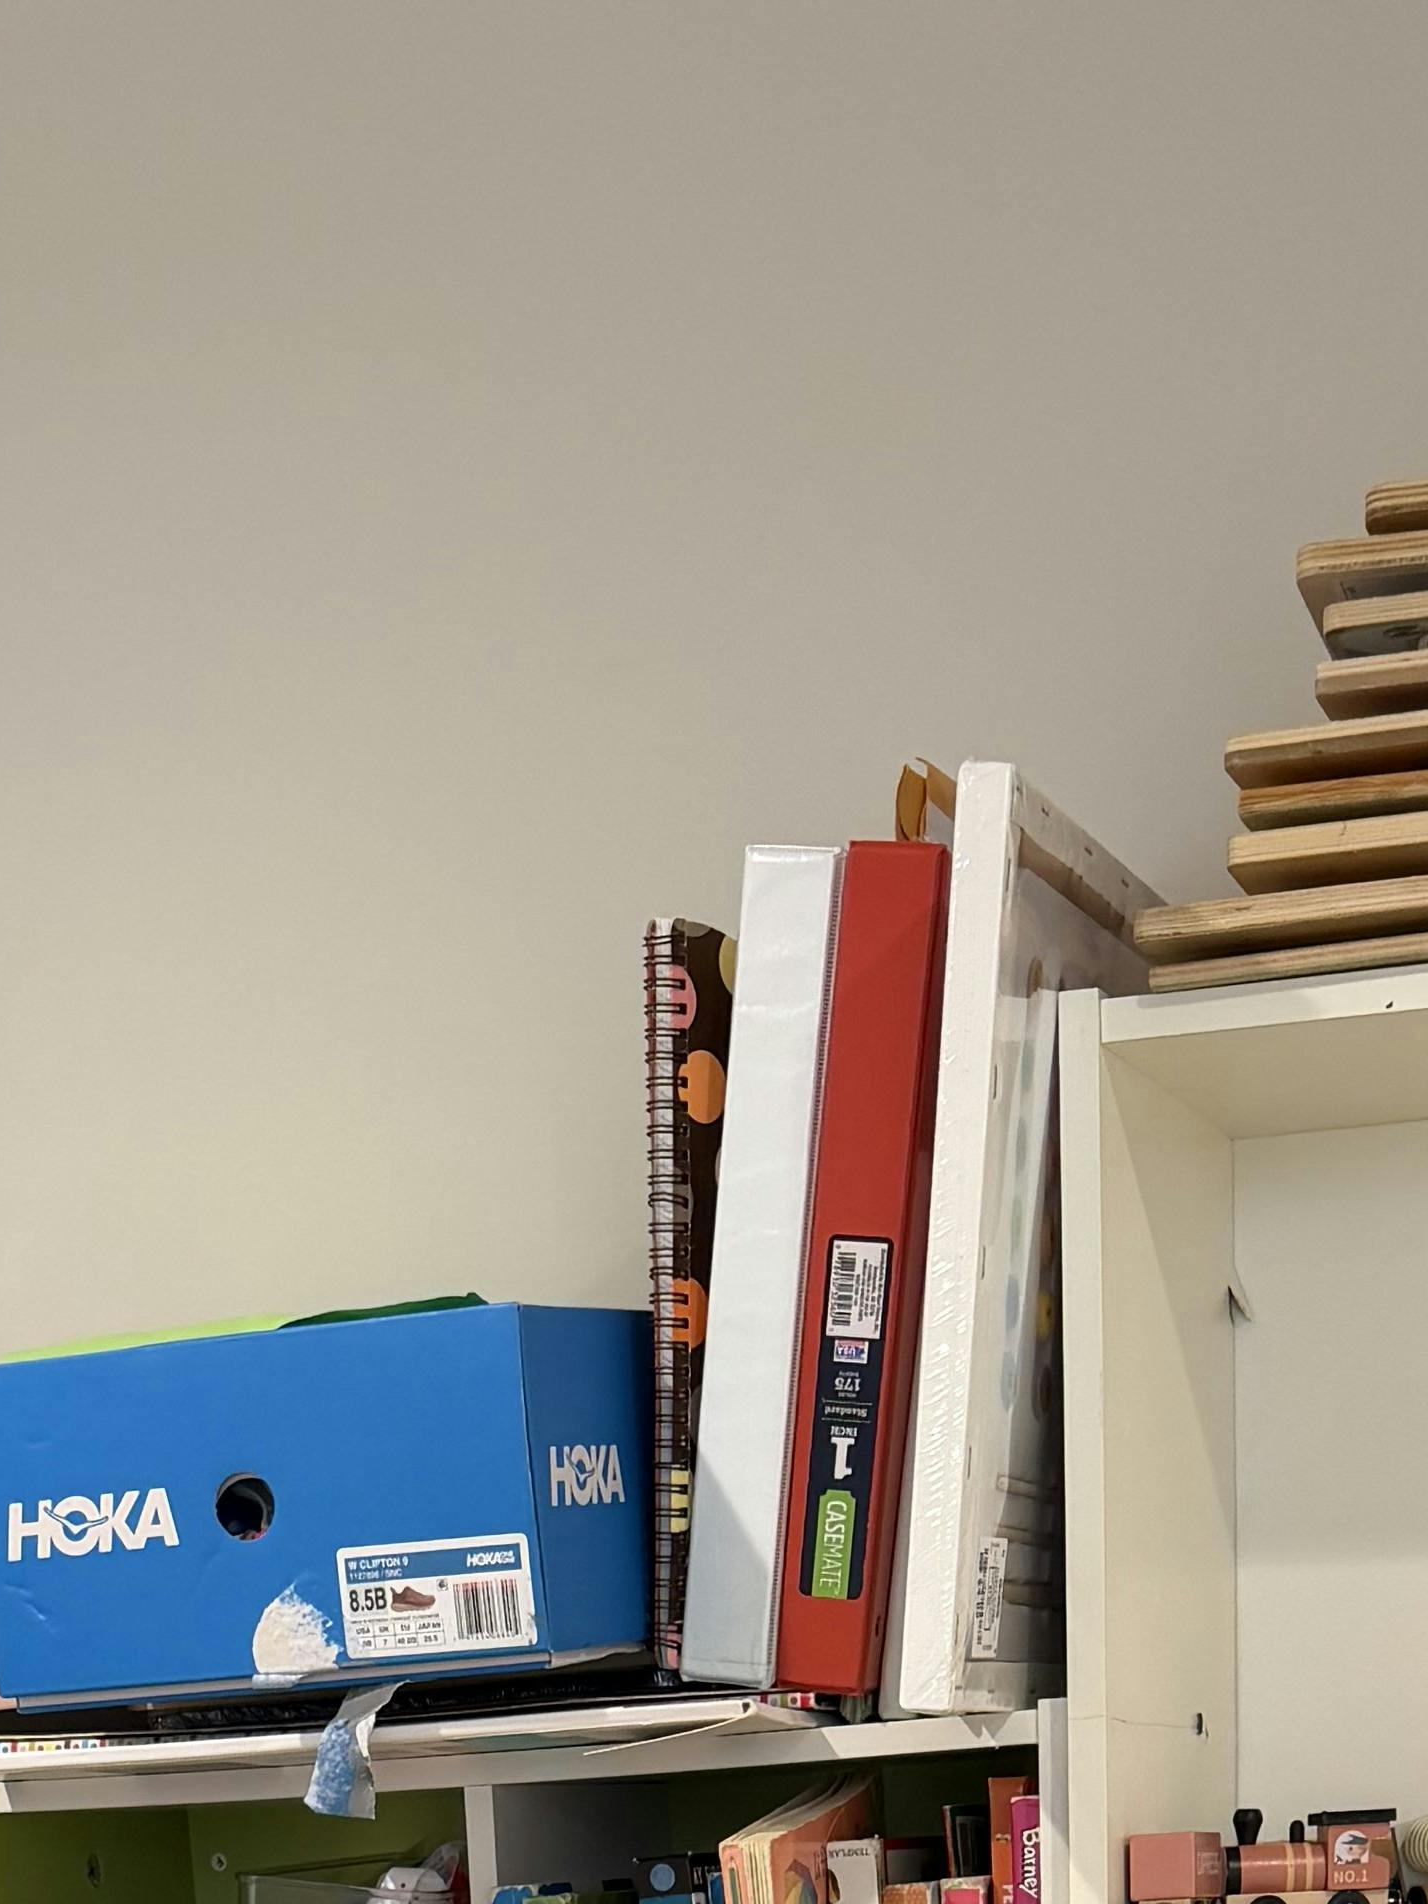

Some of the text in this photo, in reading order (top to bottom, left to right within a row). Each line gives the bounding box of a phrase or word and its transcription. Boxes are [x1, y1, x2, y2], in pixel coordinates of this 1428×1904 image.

[549, 1444, 625, 1505] HOKA
[8, 1488, 178, 1561] HOKA
[819, 1500, 848, 1587] CASEMATE
[349, 1587, 387, 1612] 8.5B
[1333, 1870, 1369, 1884] NO.1
